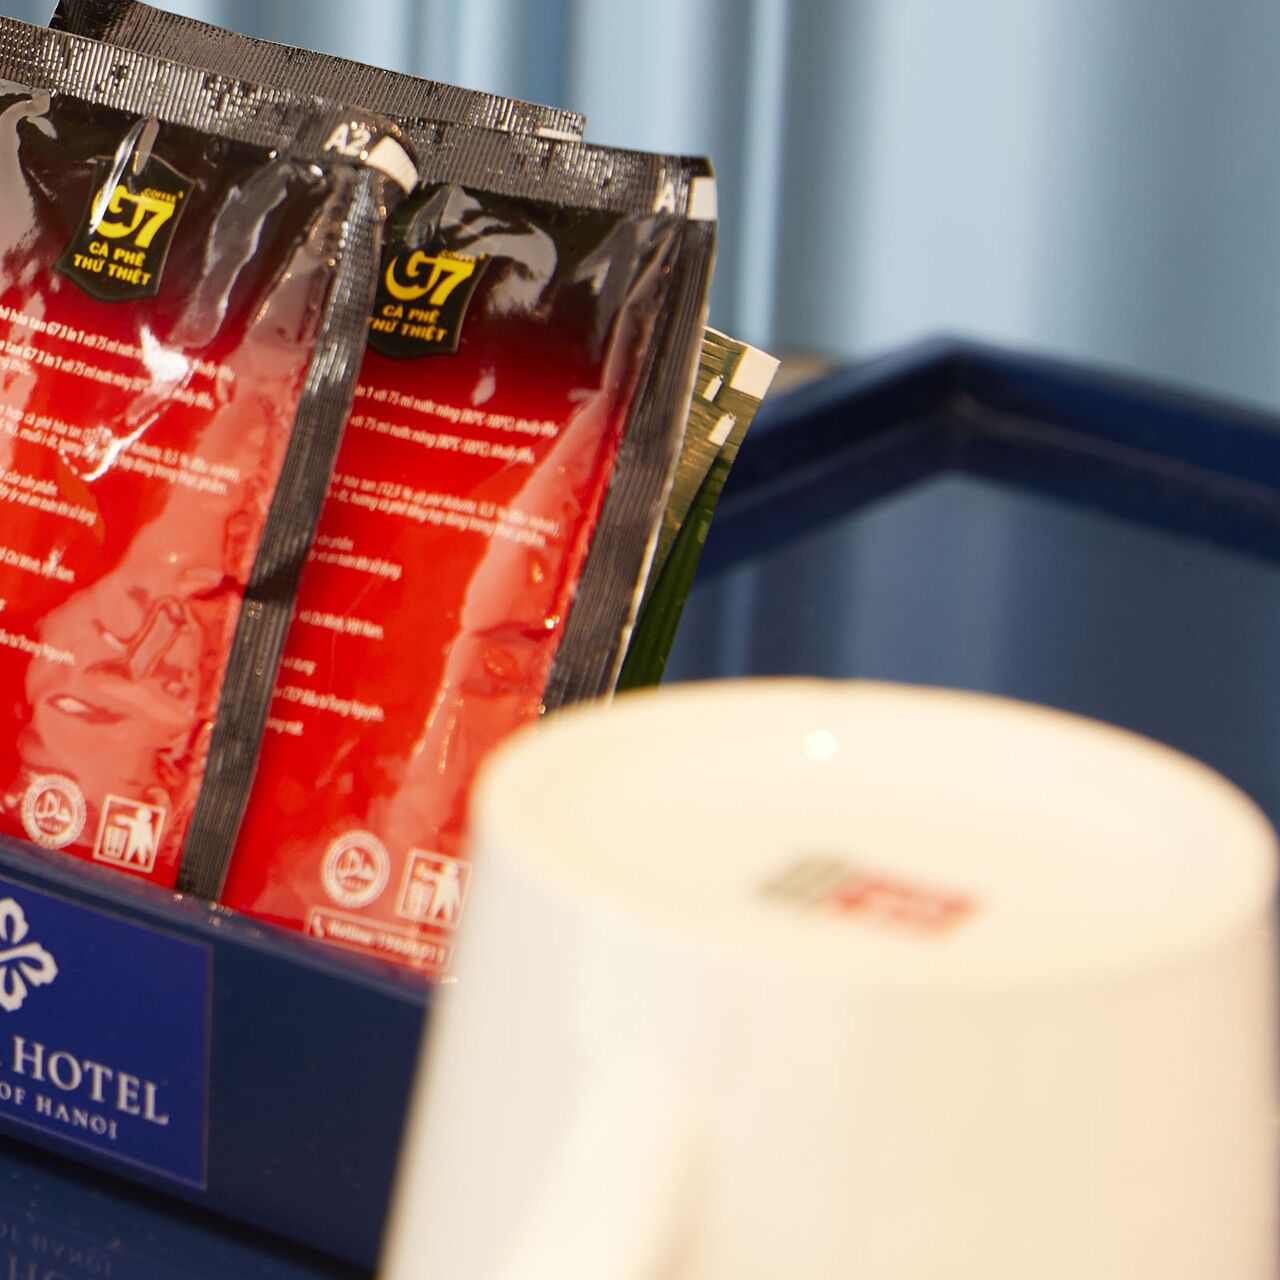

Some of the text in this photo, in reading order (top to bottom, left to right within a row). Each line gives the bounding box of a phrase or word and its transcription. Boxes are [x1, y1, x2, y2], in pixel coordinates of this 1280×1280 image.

[323, 122, 369, 155] A2
[90, 183, 176, 250] G7
[88, 242, 145, 265] CÀ PHÊ
[73, 255, 151, 285] THỨ THIỆT
[384, 248, 477, 307] G7
[382, 303, 439, 322] CÀ PHÊ
[28, 316, 46, 331] tan
[47, 322, 60, 335] G7
[60, 326, 67, 338] 3
[67, 328, 77, 341] in
[78, 331, 84, 342] 1
[401, 324, 446, 343] THIỆT
[6, 342, 22, 357] tan
[22, 346, 36, 359] G7
[36, 351, 43, 363] 3
[44, 354, 55, 367] in
[55, 357, 62, 368] 1
[12, 1035, 169, 1125] HOTEL
[35, 1095, 117, 1140] HANOI
